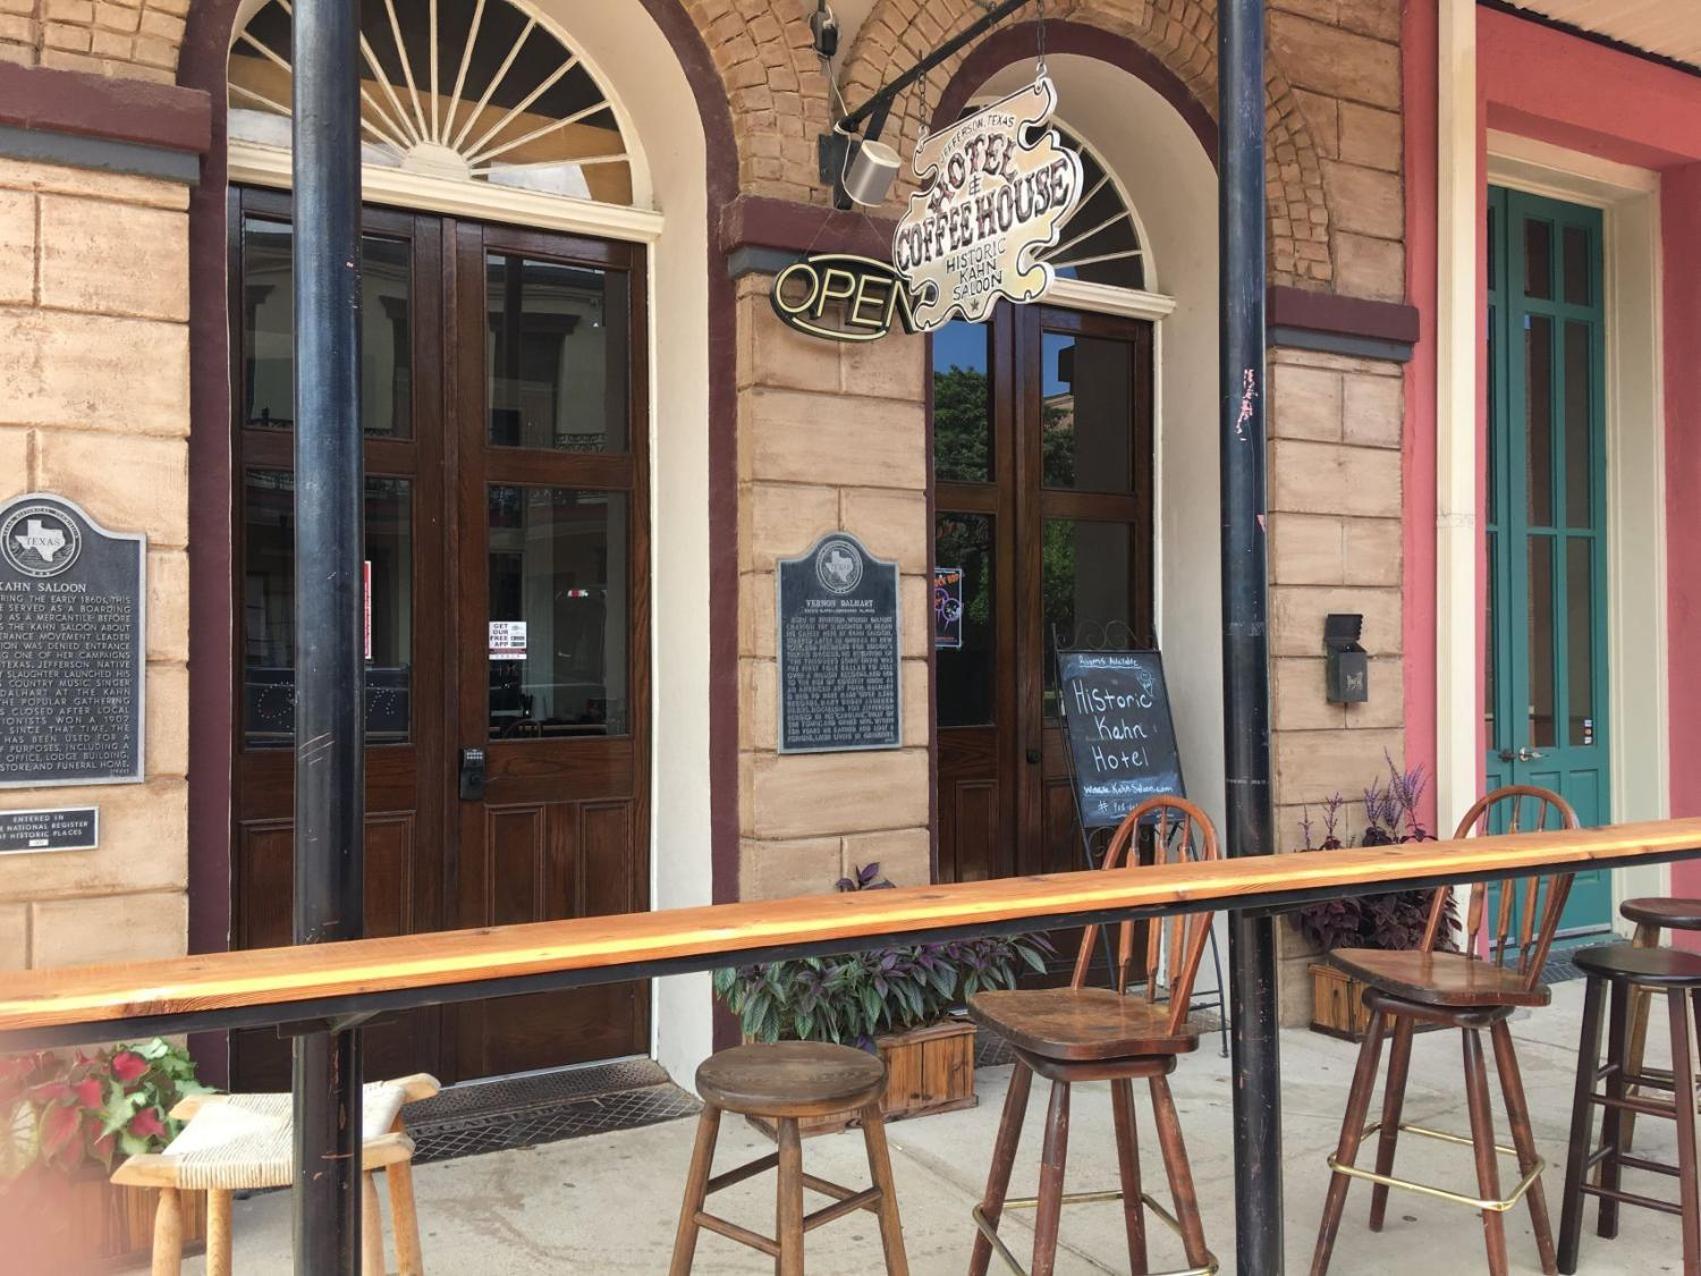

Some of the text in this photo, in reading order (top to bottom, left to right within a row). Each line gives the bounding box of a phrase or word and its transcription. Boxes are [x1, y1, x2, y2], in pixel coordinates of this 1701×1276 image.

[988, 114, 1015, 128] TEXAS
[928, 133, 1018, 213] HOTEL
[946, 236, 1007, 275] HISTORIC
[959, 258, 997, 285] KAHN
[953, 270, 1003, 301] SALOON
[776, 263, 926, 333] OPEN
[27, 537, 61, 546] TEXAS
[38, 583, 87, 593] SALOON
[8, 603, 45, 612] SERVED
[50, 604, 62, 613] AS
[68, 605, 75, 613] A
[80, 605, 132, 614] BOARDING
[9, 623, 25, 631] THE
[30, 623, 56, 631] KAHN
[60, 623, 97, 632] SALOON
[101, 623, 132, 632] ABOUT
[40, 633, 92, 641] MOVEMENT
[96, 633, 130, 642] LEADER
[48, 642, 80, 651] DENIED
[85, 642, 131, 651] ENTRANCE
[14, 651, 33, 659] ONE
[79, 651, 131, 660] CAMPAIGNS
[97, 661, 131, 669] NATIVE
[8, 679, 54, 688] COUNTRY
[95, 679, 131, 687] SINGER
[103, 688, 131, 696] KAHN
[59, 707, 91, 715] AFTER
[98, 706, 129, 714] LOCAL
[9, 726, 41, 735] SINCE
[4, 735, 25, 744] HAS
[65, 743, 119, 752] INCLUDING
[1091, 745, 1150, 773] Hotel
[57, 760, 98, 771] FUNERAL
[7, 824, 48, 832] NATIONAL
[51, 820, 89, 830] REGISTER
[9, 830, 50, 840] HISTORIC
[52, 828, 83, 838] PLACES
